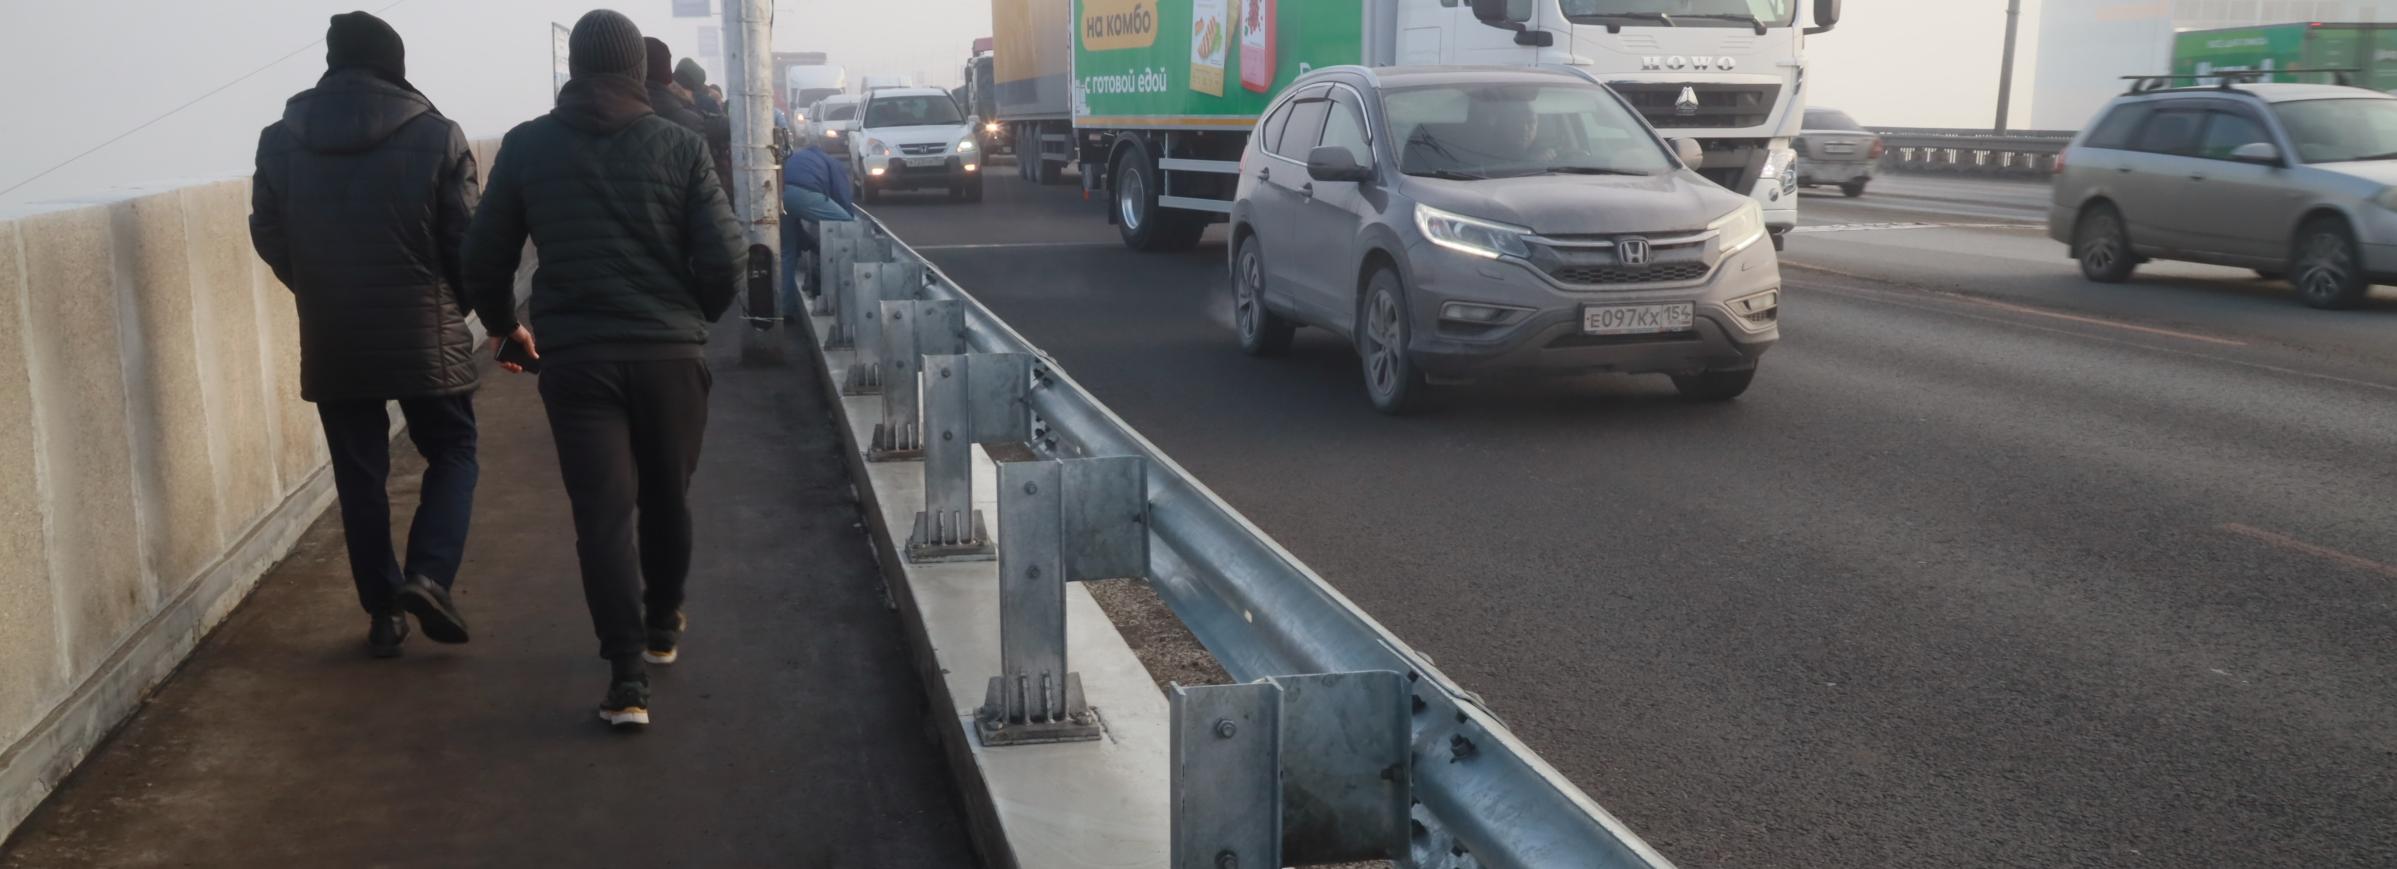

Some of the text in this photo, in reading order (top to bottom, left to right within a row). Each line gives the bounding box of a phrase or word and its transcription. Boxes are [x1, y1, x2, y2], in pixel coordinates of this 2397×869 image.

[1087, 4, 1151, 38] на комбо
[1641, 55, 1736, 71] HOWO
[1085, 77, 1091, 94] с
[1093, 68, 1135, 94] готовой
[1138, 66, 1167, 92] едой
